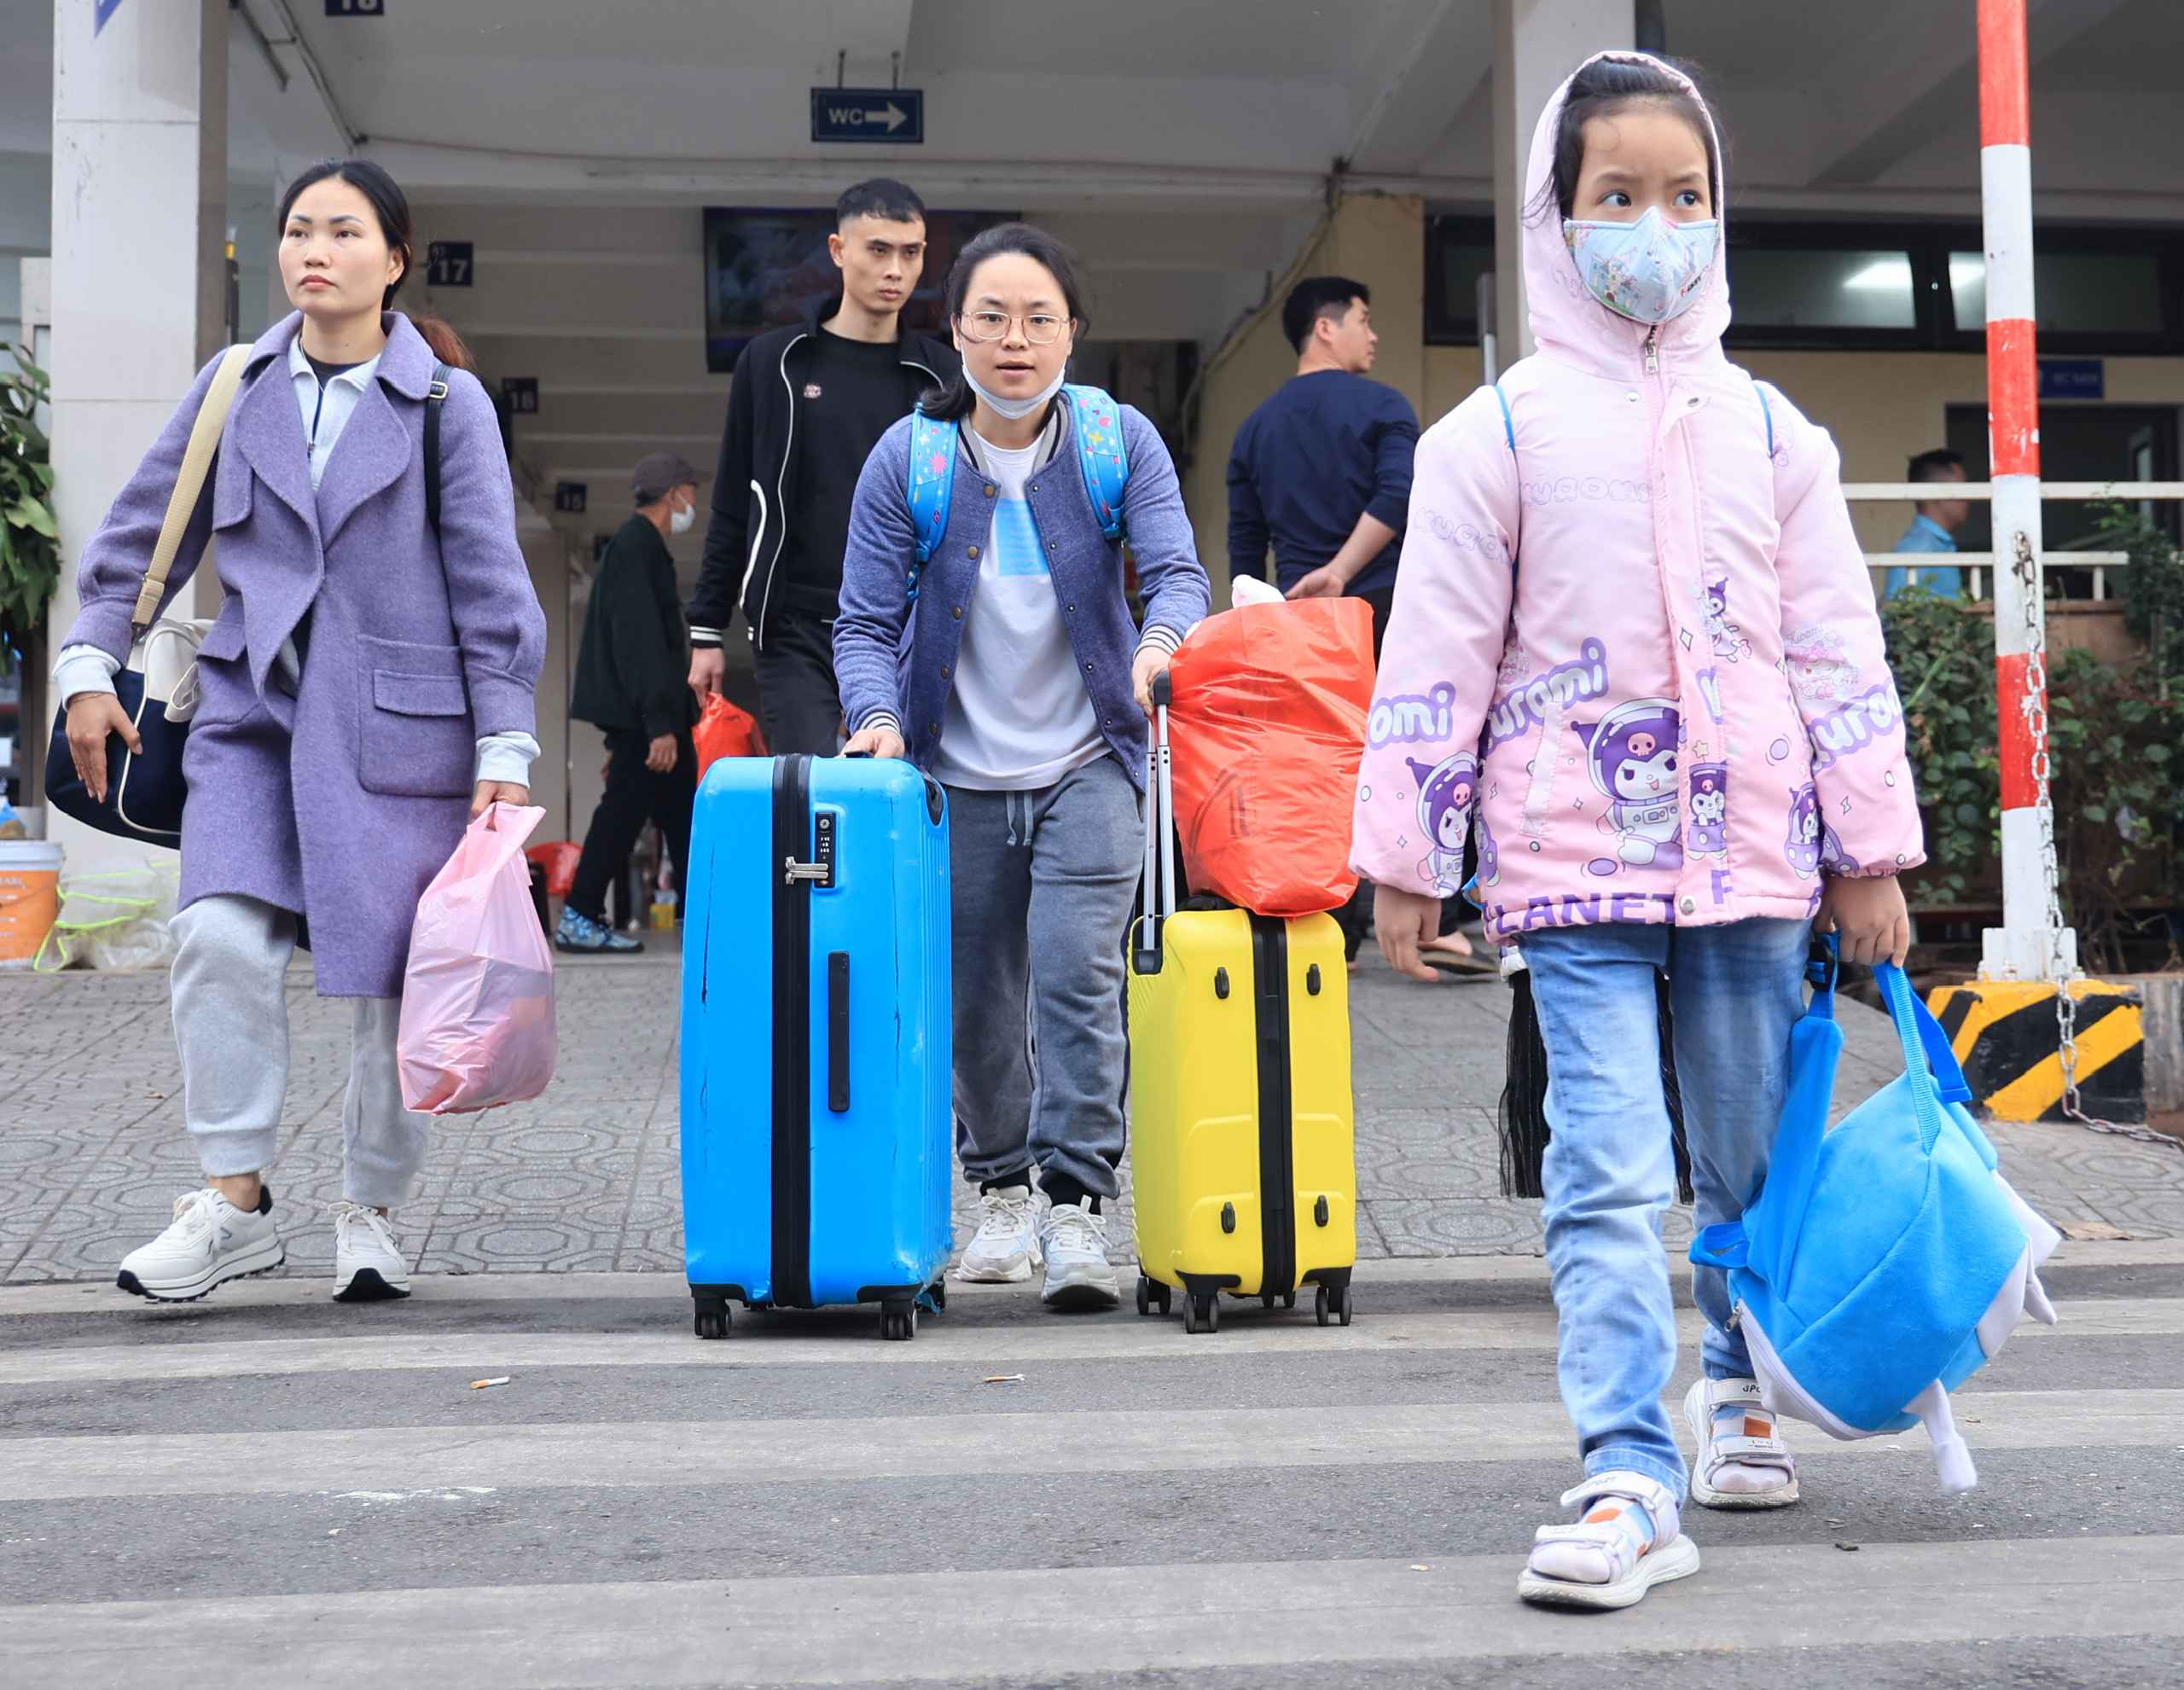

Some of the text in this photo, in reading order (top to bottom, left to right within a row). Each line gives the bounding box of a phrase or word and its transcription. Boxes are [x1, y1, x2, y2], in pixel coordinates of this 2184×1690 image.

[828, 107, 863, 125] WC
[437, 258, 468, 282] 17
[1487, 638, 1608, 754] uromi
